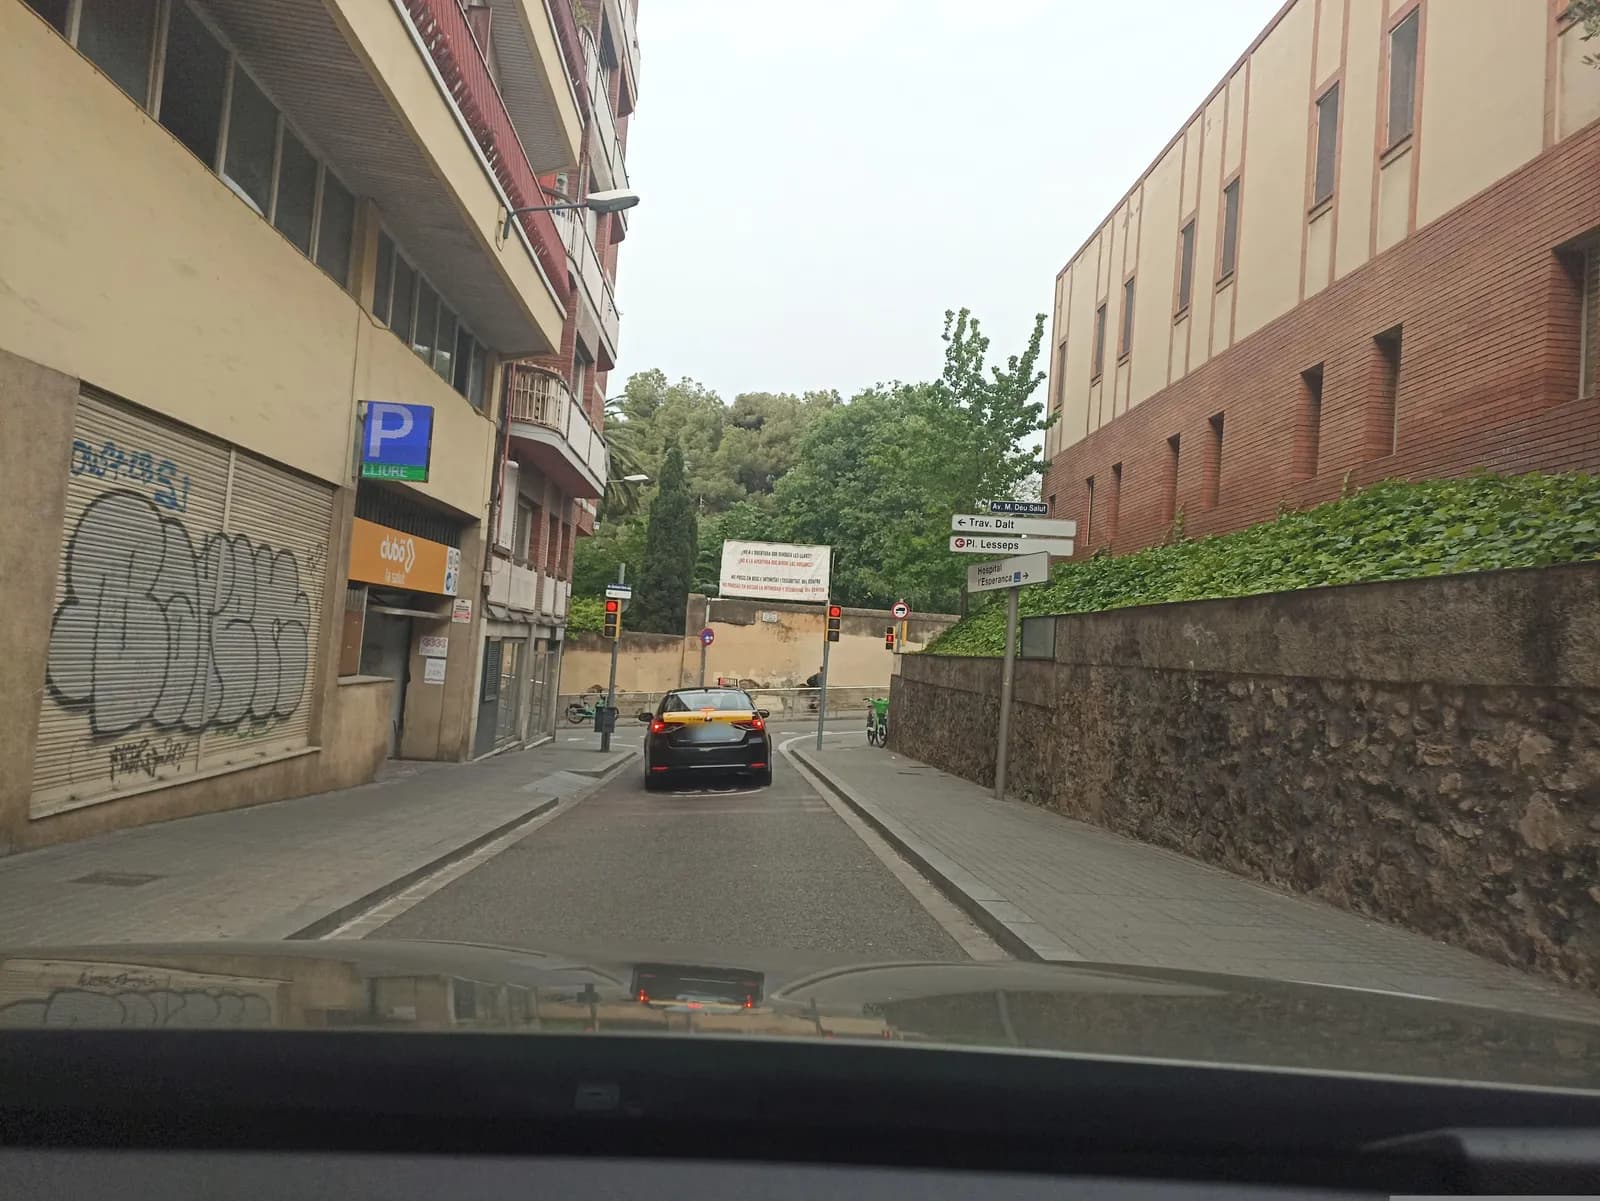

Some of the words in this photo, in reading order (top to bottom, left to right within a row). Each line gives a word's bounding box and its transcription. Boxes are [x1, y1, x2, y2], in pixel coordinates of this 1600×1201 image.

[369, 403, 413, 457] P
[362, 463, 408, 478] LLIURE
[1004, 503, 1012, 511] M.
[1029, 504, 1046, 512] Salut
[969, 517, 992, 528] Trav.
[995, 519, 1014, 529] Dalt
[966, 538, 977, 548] Pl.
[980, 540, 1019, 551] Lesseps
[977, 563, 1002, 575] Hospital
